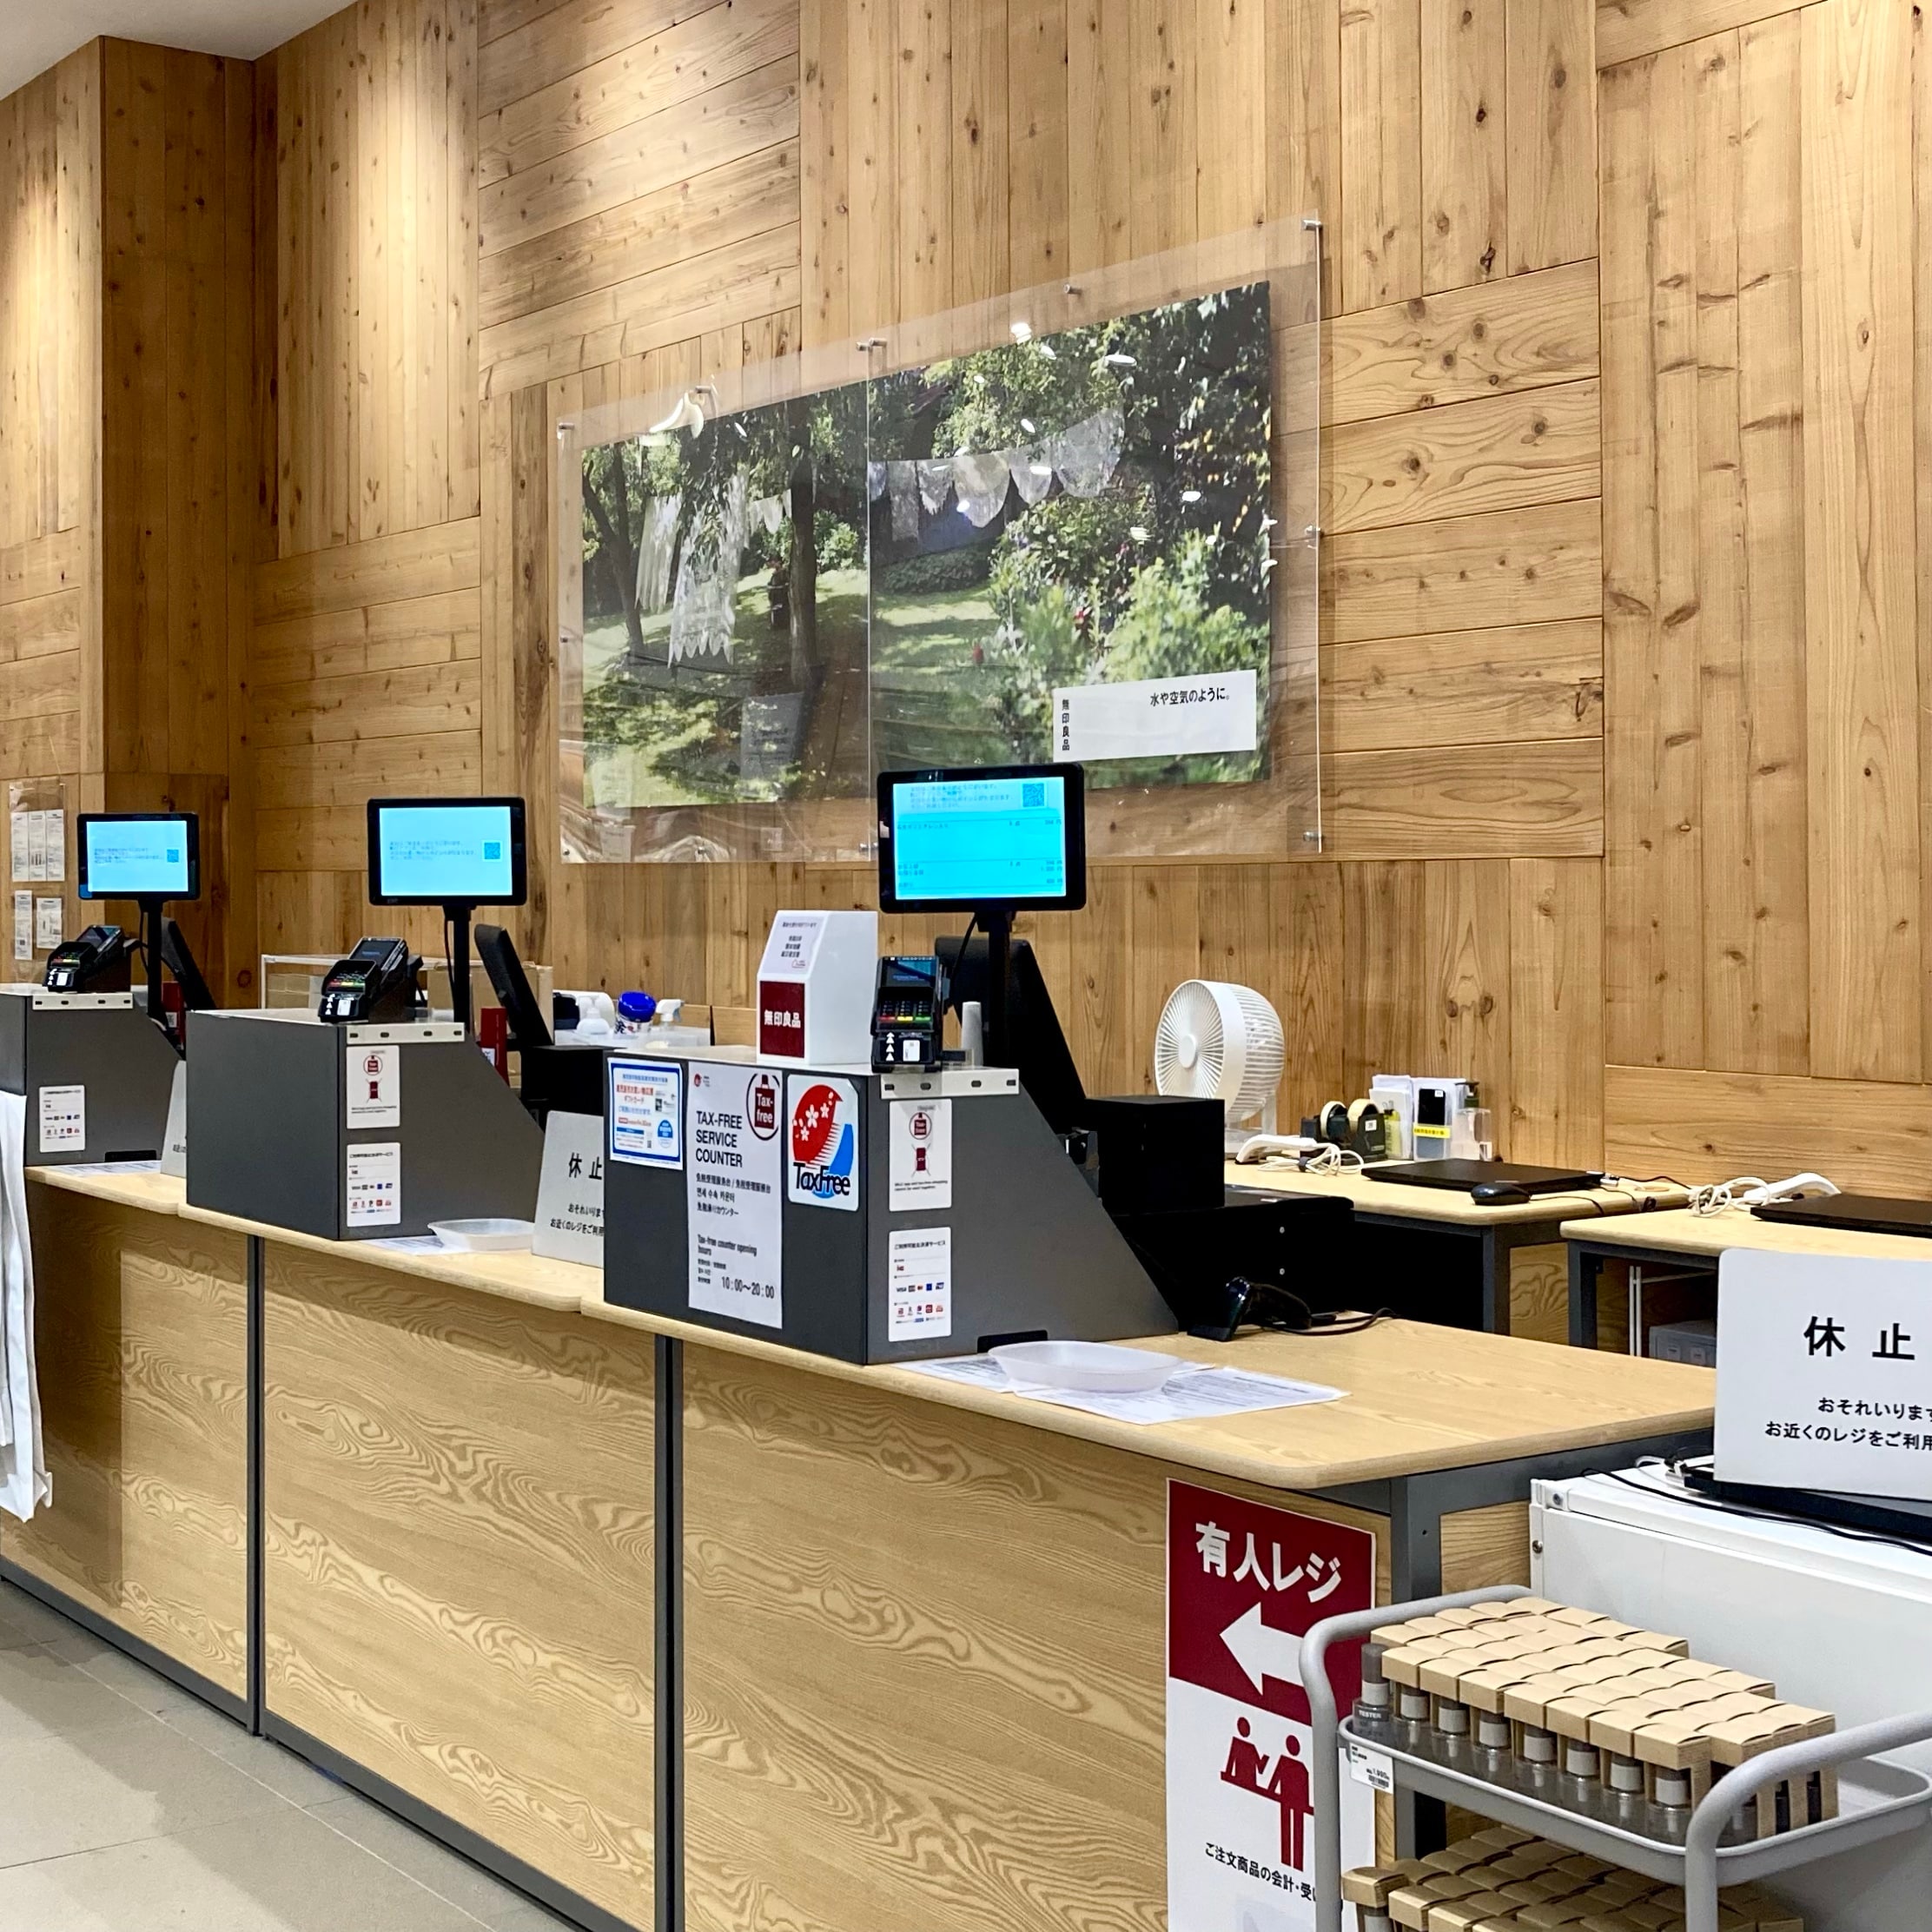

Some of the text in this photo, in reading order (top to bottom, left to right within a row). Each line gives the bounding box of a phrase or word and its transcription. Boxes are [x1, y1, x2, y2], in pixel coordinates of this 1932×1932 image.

[1150, 687, 1229, 706] 水や空気のように。
[764, 1009, 800, 1028] 無印良品
[756, 1093, 773, 1107] Tax-
[696, 1110, 742, 1128] TAX-FREE
[756, 1108, 772, 1123] free
[696, 1128, 737, 1148] SERVICE
[568, 1152, 602, 1180] 休止
[696, 1148, 742, 1168] COUNTER
[793, 1161, 850, 1195] TaxFree
[568, 1202, 604, 1217] おそれいりま
[1803, 1315, 1915, 1360] 休止
[1195, 1520, 1341, 1603] 有人レジ
[1358, 1709, 1381, 1718] TESTER
